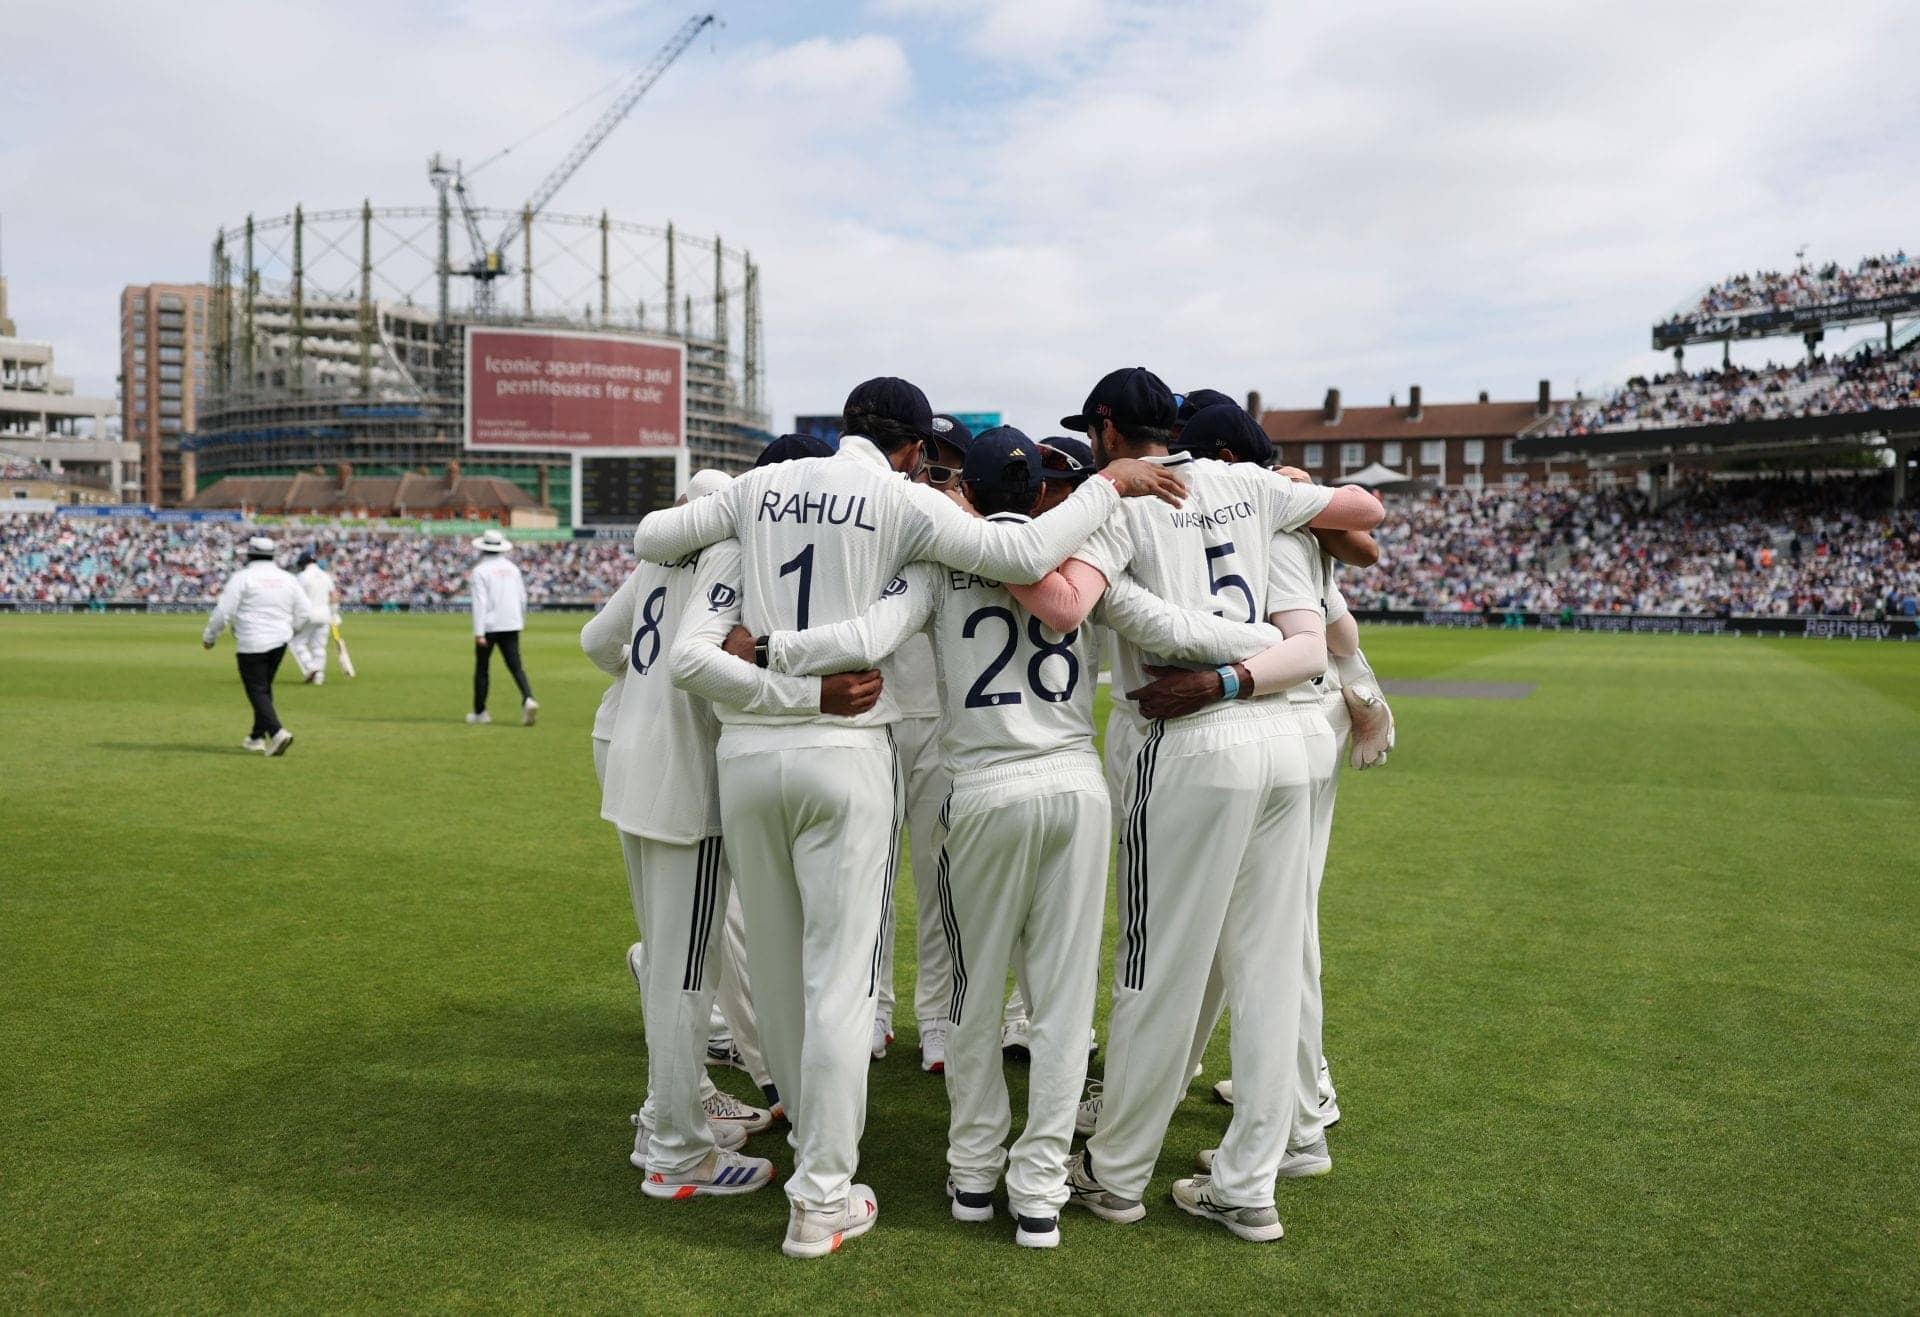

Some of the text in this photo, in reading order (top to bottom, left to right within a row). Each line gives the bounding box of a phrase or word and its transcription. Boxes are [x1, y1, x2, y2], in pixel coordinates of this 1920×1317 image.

[485, 355, 672, 385] Iconic apartments and
[496, 379, 663, 403] penthouses for sale
[758, 490, 875, 531] RAHUL
[1170, 501, 1256, 530] WASHNGTON
[779, 544, 814, 632] 1
[1205, 541, 1256, 624] 5
[632, 586, 667, 676] 8
[1805, 617, 1892, 638] Rothesay
[962, 606, 1079, 709] 28
